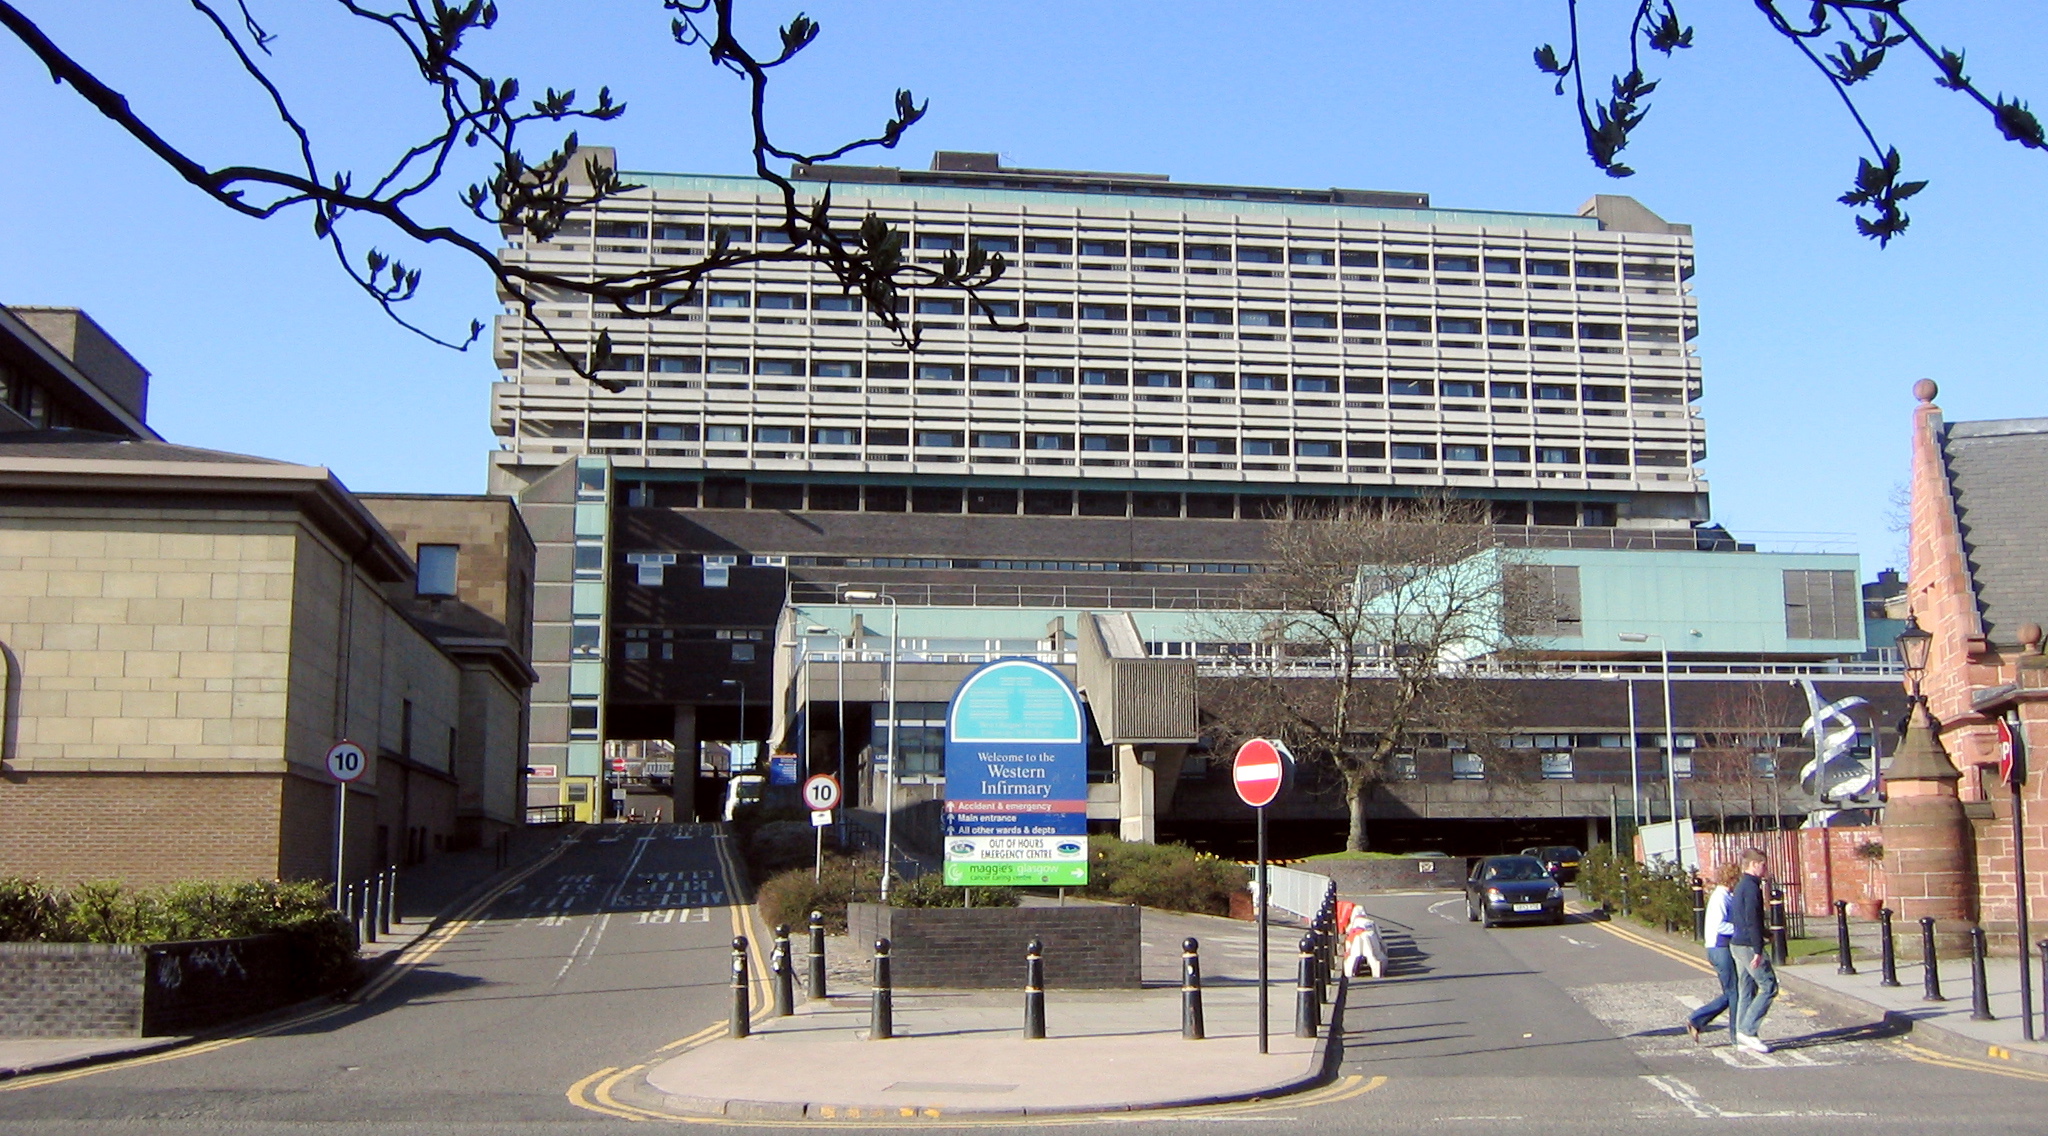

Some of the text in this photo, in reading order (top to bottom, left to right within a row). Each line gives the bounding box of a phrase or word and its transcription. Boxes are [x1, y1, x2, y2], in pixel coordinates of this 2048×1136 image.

[335, 752, 359, 771] 10
[978, 752, 1056, 762] Welcome to the
[987, 764, 1046, 779] Western
[811, 785, 832, 801] 10
[981, 780, 1052, 798] Infirmary
[958, 801, 1052, 813] Accident & emergency
[957, 814, 1018, 823] Main entrance
[958, 826, 1056, 836] All other wards & depts
[989, 839, 1044, 848] OUT OF HOURS
[981, 849, 1052, 859] EMERGENCY CENTRE
[1016, 863, 1059, 876] glasgow
